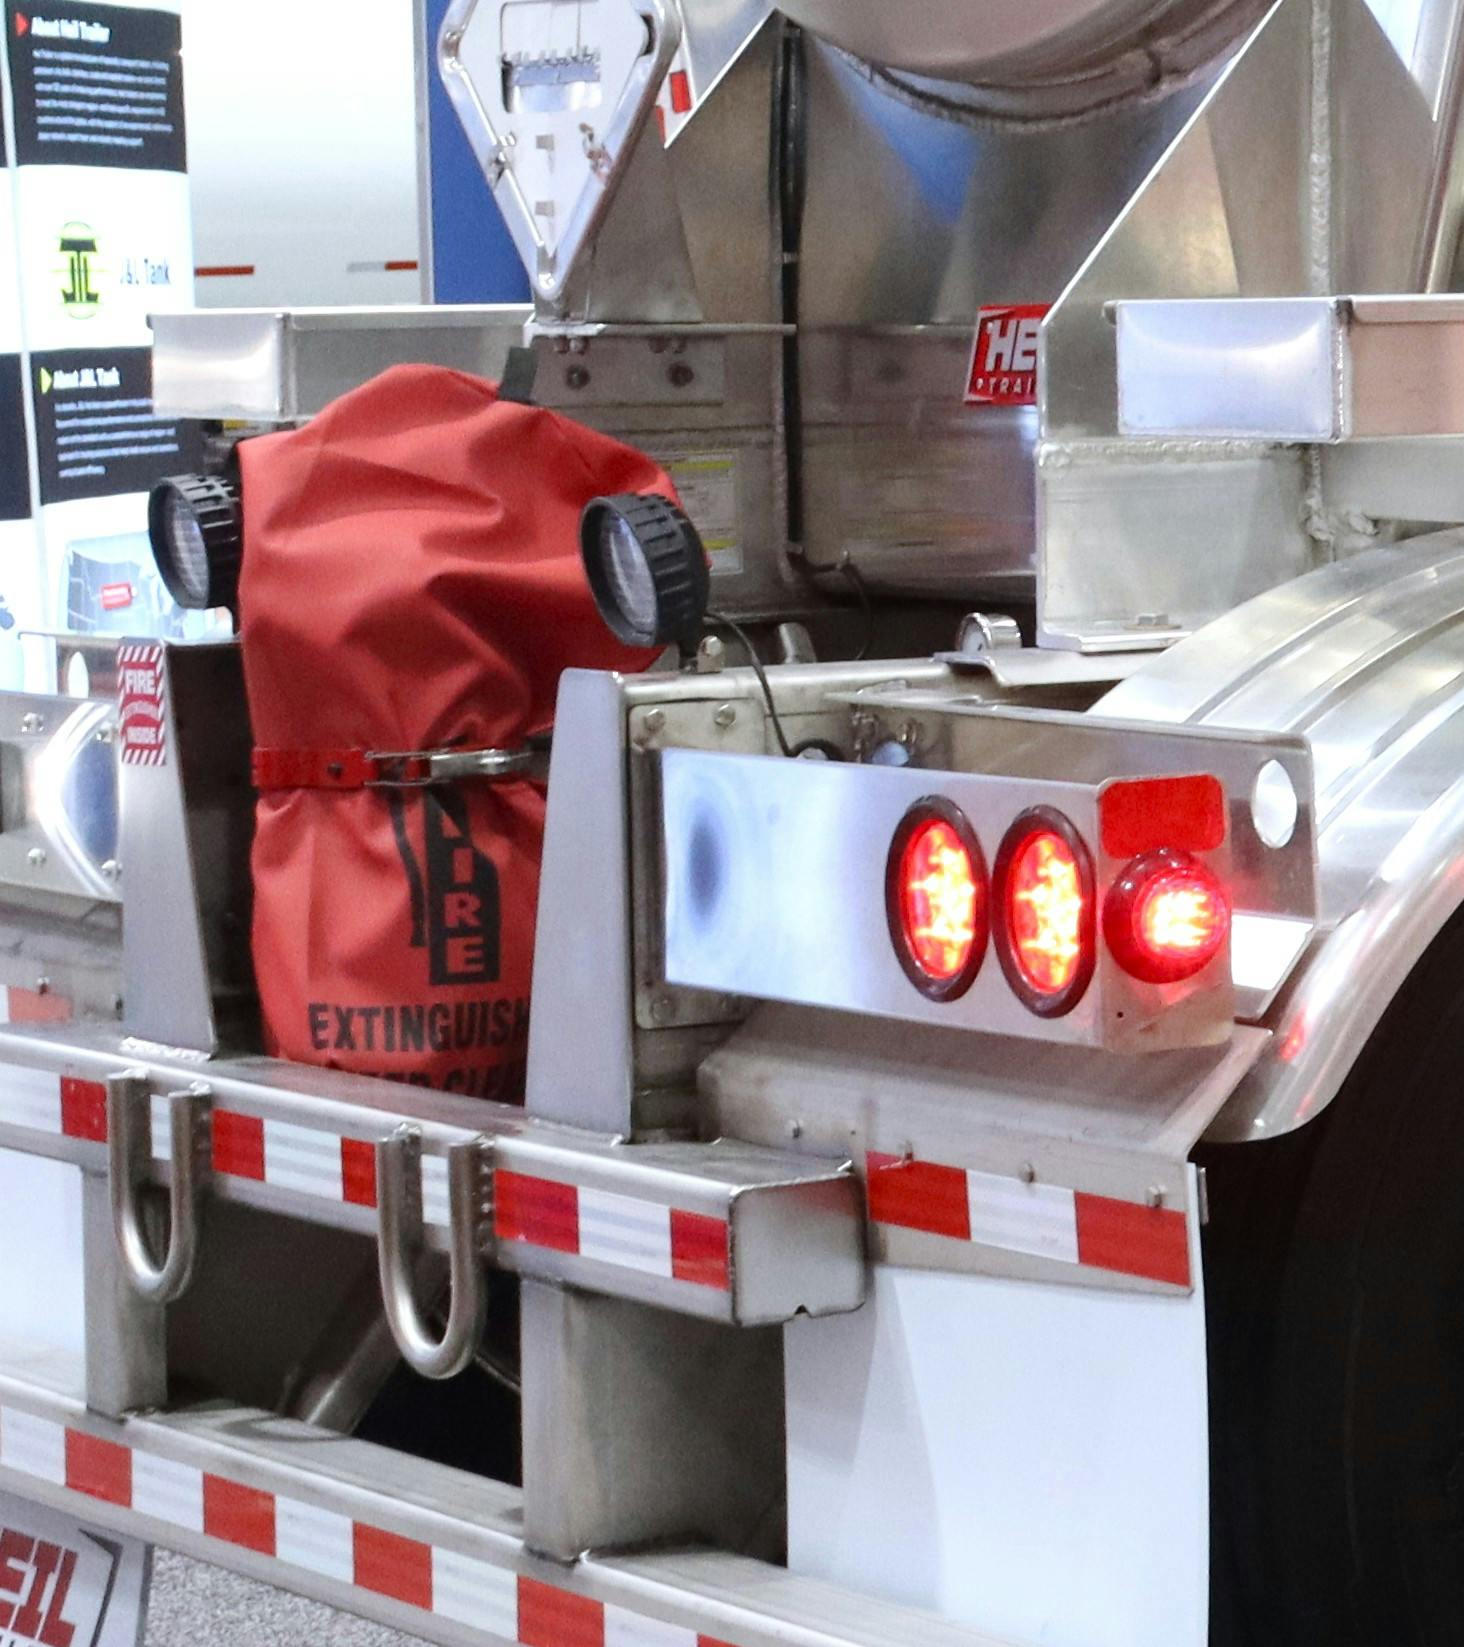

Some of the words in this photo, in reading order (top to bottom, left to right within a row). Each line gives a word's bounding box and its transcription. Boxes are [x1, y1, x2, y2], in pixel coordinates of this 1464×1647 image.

[985, 318, 1040, 372] HE
[988, 377, 1033, 394] TRAI
[125, 668, 156, 695] FIRE
[0, 1526, 79, 1647] EIL
